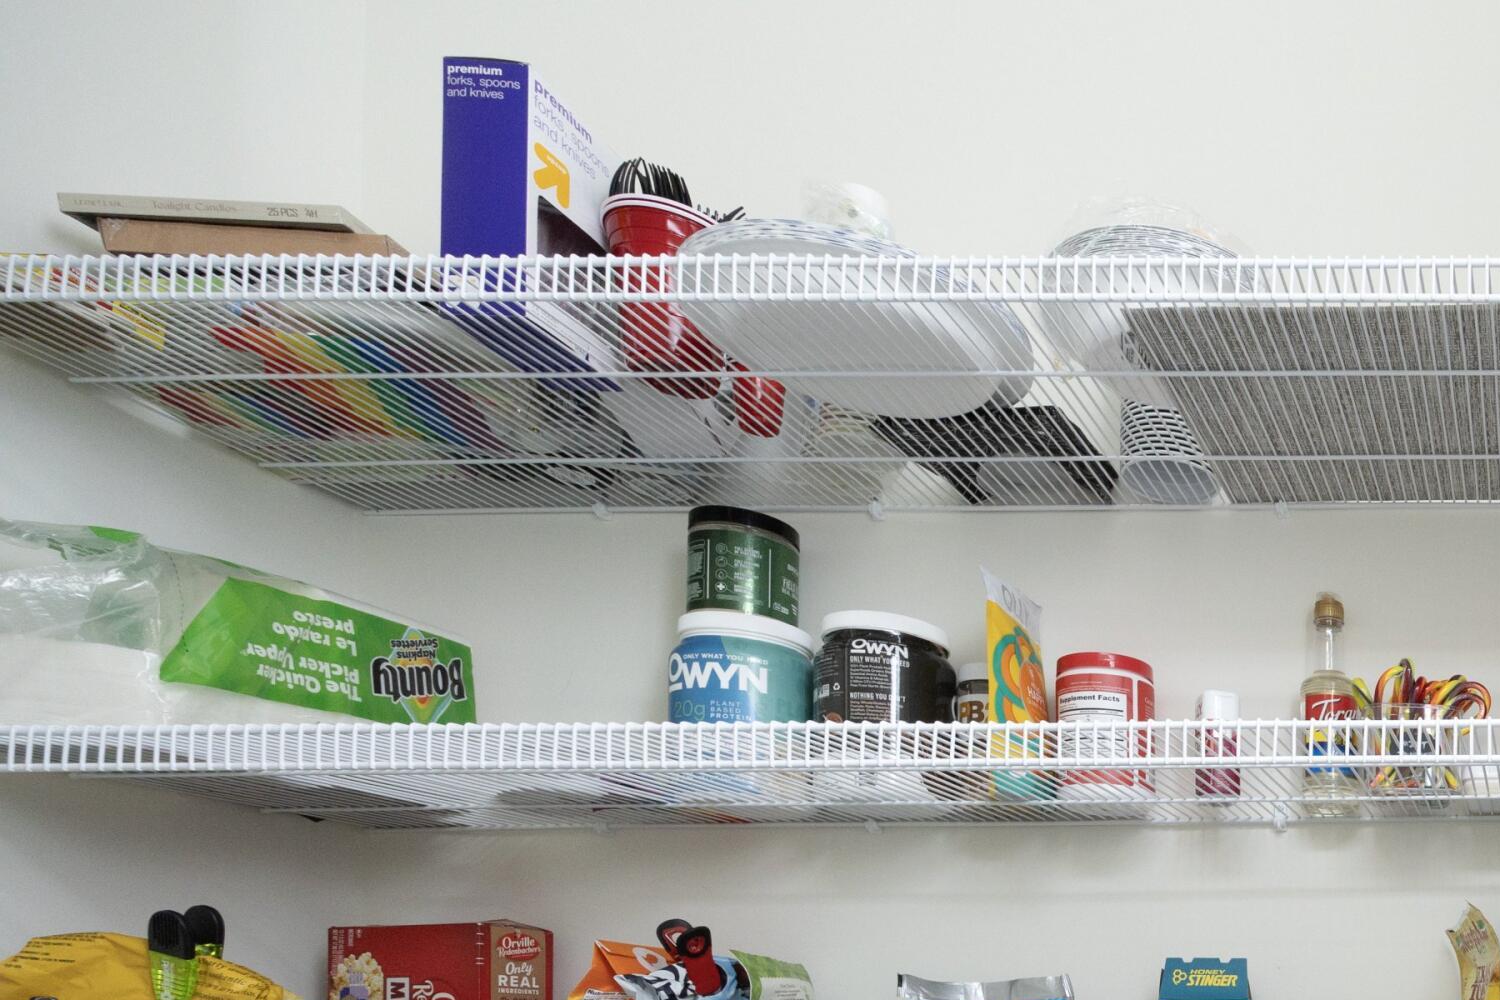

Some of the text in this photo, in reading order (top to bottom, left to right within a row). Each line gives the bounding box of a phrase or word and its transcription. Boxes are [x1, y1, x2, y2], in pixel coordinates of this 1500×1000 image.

[447, 65, 503, 76] premium
[447, 76, 521, 89] forks, spoons
[447, 88, 504, 100] and knives
[535, 79, 592, 144] premium
[534, 115, 596, 180] and knives
[293, 610, 355, 635] presto
[334, 638, 357, 657] Le
[390, 638, 438, 649] Serviettes
[850, 638, 909, 660] OWYN
[396, 650, 436, 660] Napkins
[683, 652, 699, 660] ONLY
[701, 652, 726, 660] WHAT
[300, 660, 360, 685] Picker
[370, 656, 466, 702] Bounty
[669, 652, 768, 694] OWYN
[256, 663, 362, 702] The Quicker
[1098, 694, 1120, 702] Facts
[502, 936, 535, 949] Orville
[505, 961, 533, 976] Only
[498, 974, 540, 989] REAL
[1187, 974, 1238, 987] STINGER
